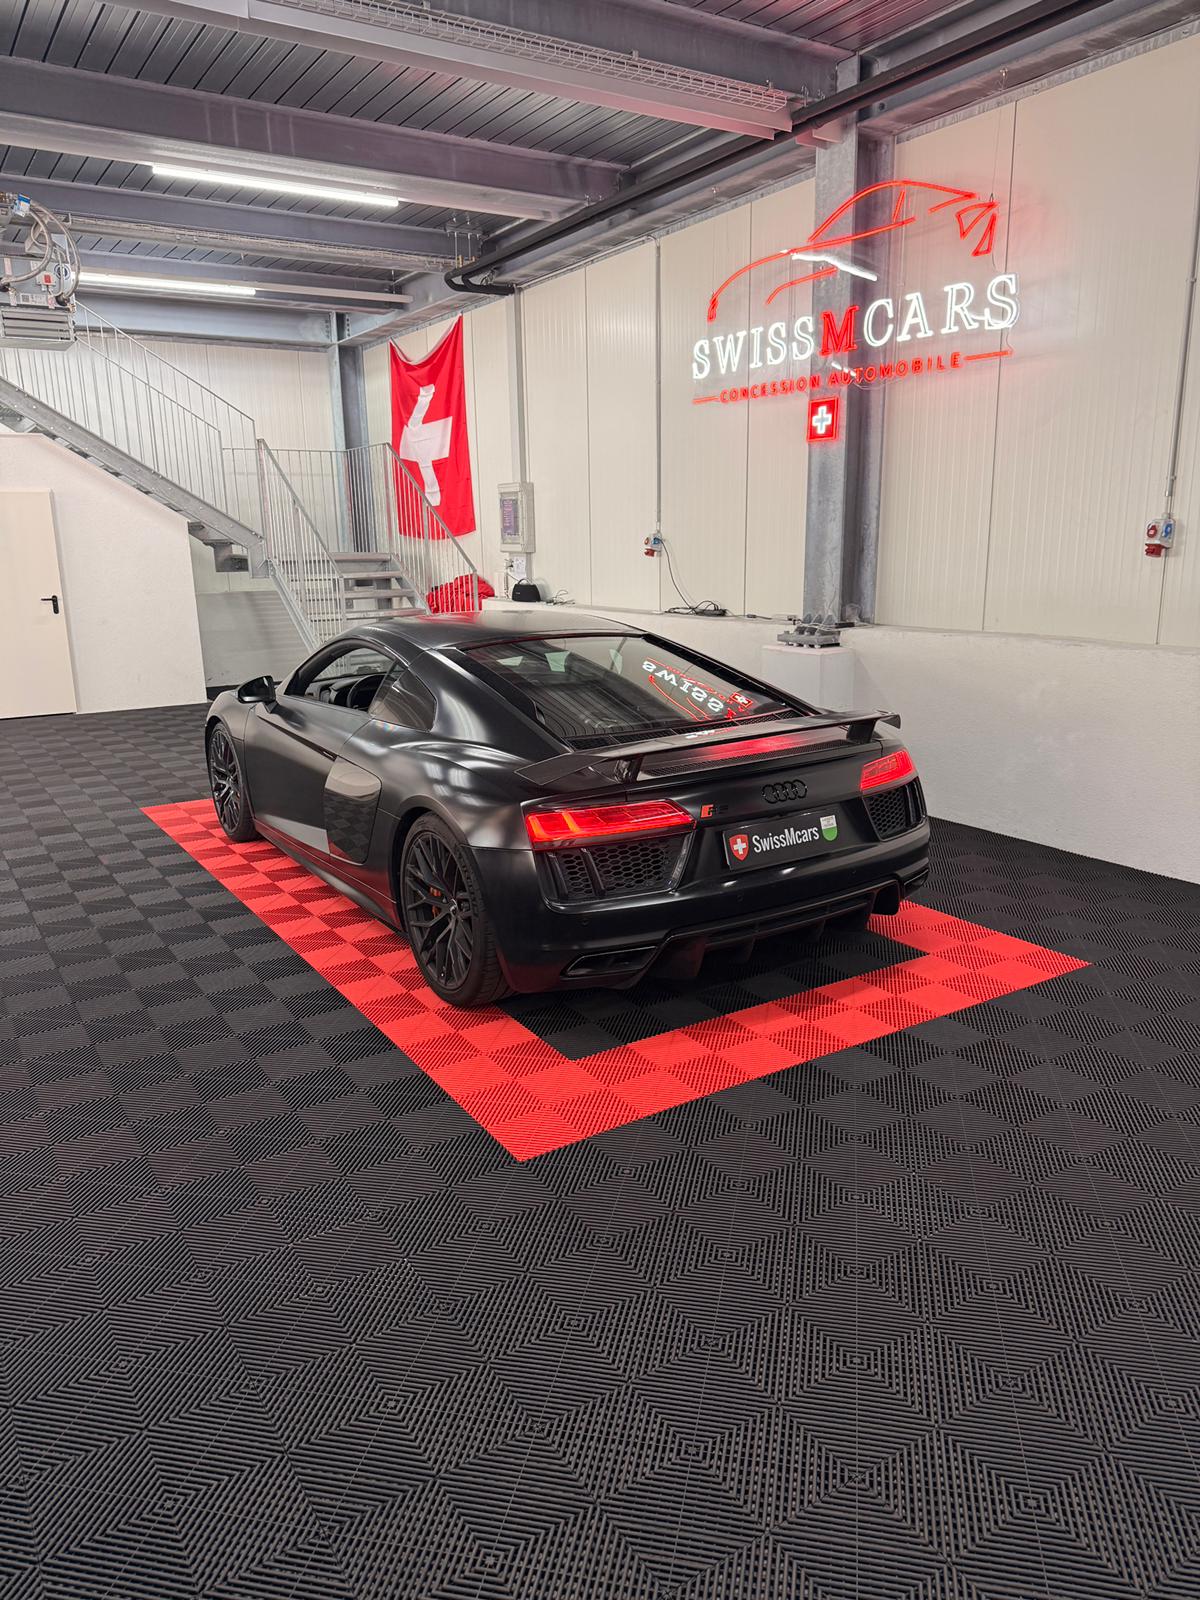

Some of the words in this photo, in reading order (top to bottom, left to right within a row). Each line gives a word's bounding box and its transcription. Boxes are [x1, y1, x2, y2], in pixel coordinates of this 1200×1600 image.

[692, 273, 1020, 379] SWISSMCARS
[719, 374, 822, 403] CONCESSION
[827, 351, 962, 386] AUTOMOBILE
[752, 827, 820, 853] SwissMcars
